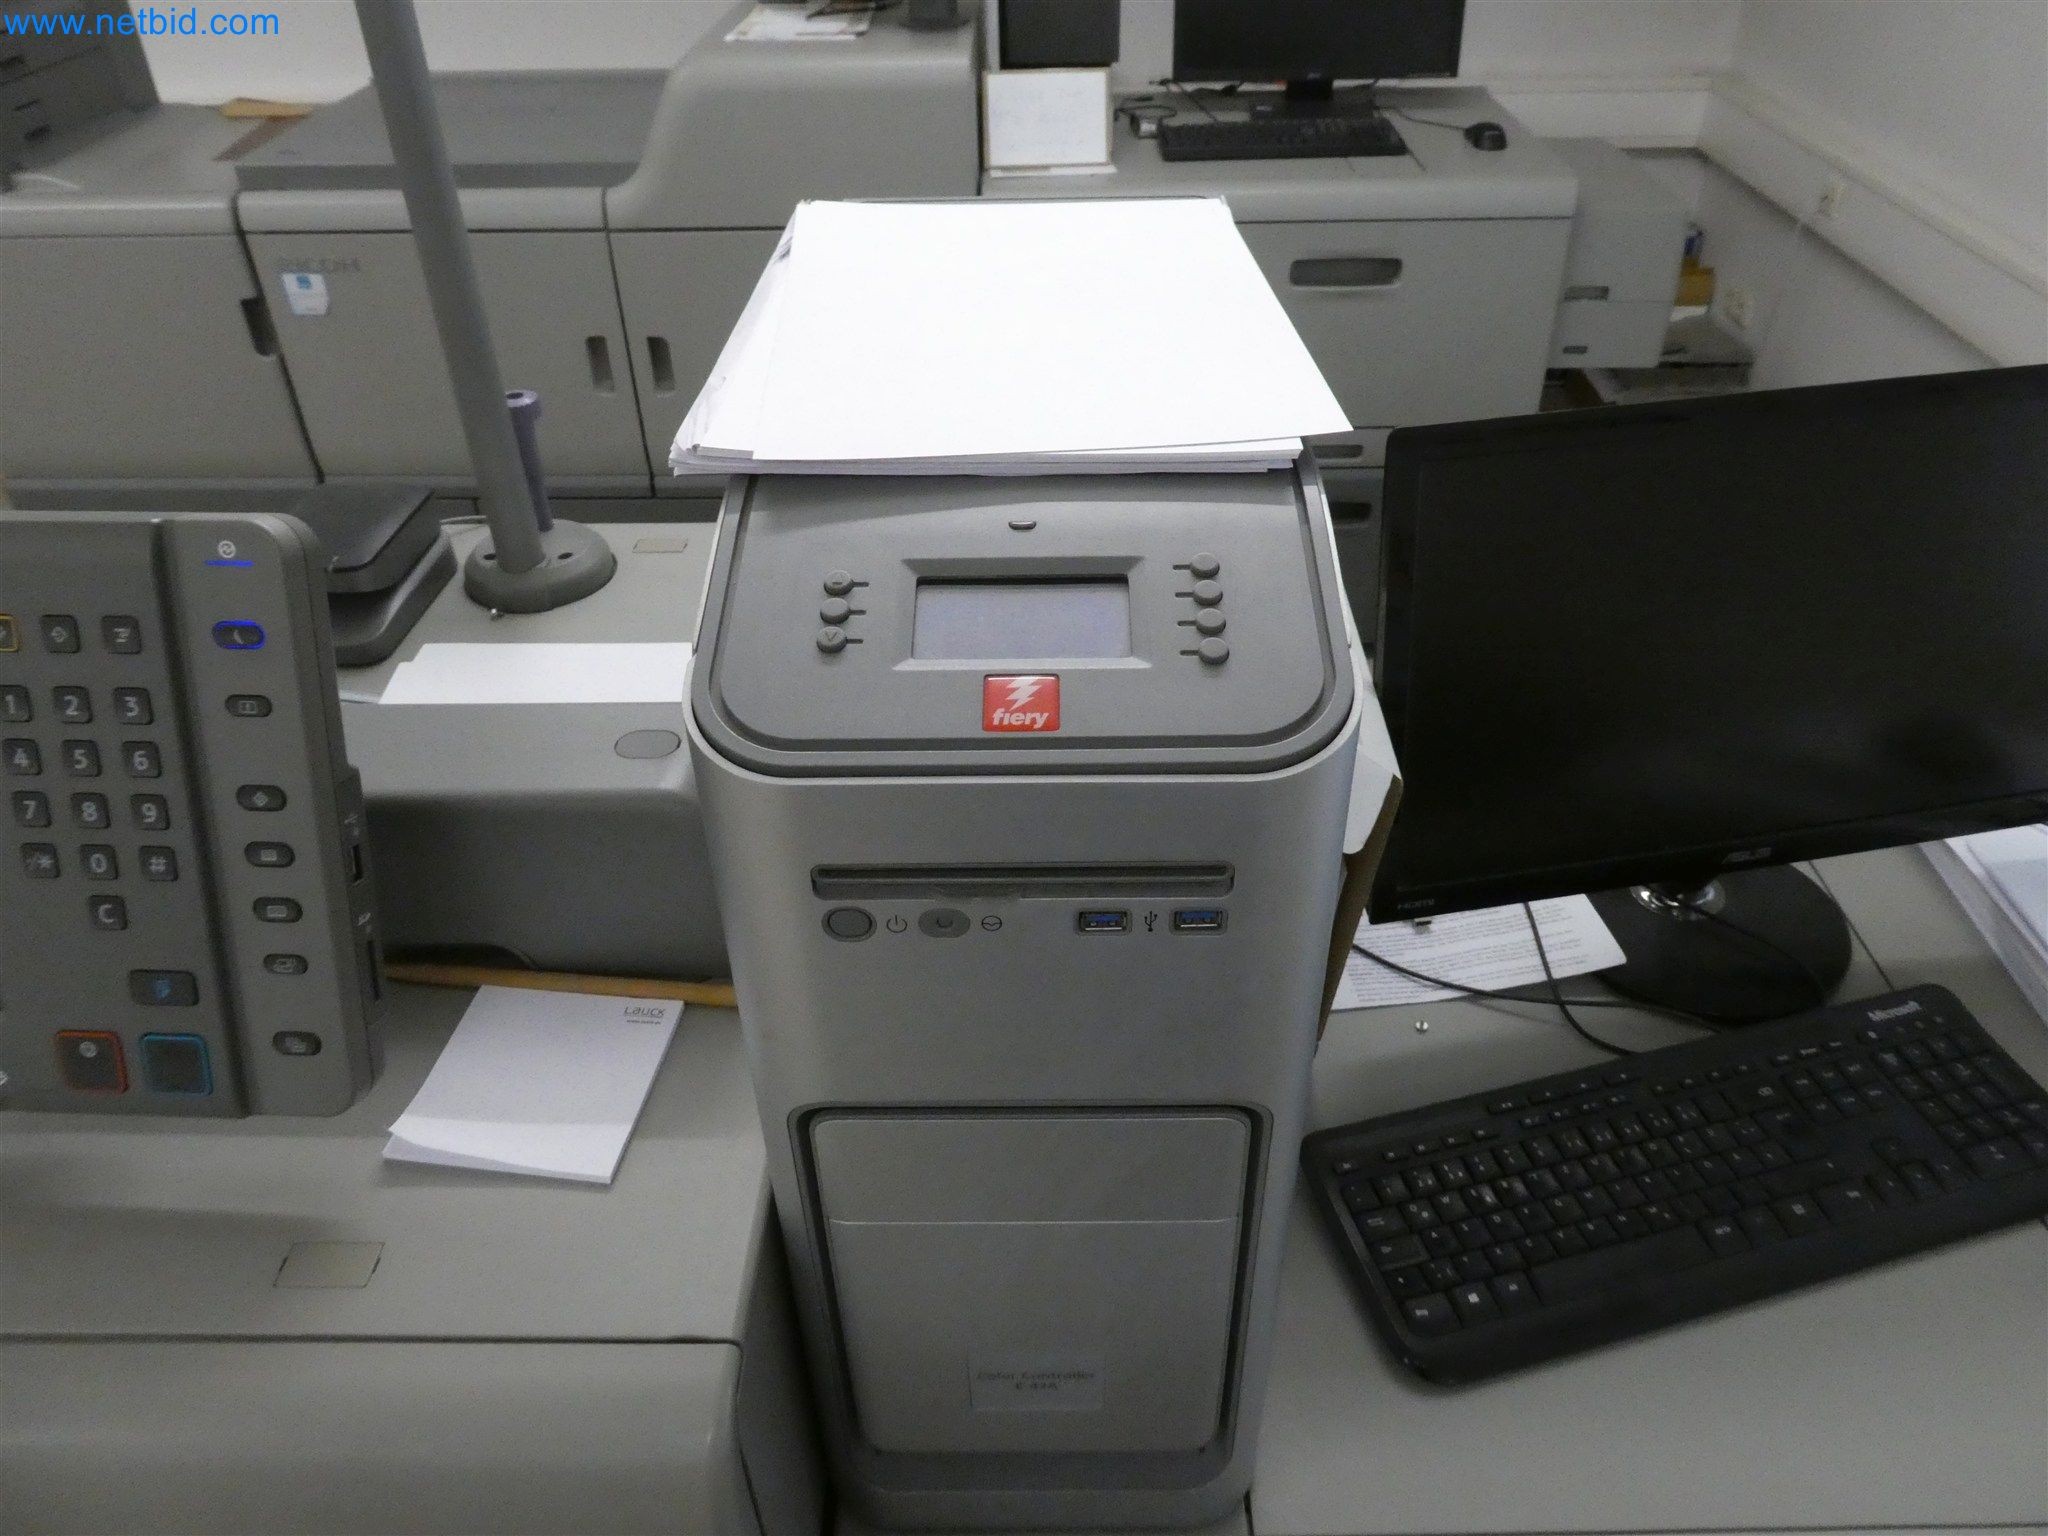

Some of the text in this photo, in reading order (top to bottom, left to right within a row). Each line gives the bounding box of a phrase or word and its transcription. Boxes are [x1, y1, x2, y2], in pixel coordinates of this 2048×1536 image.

[4, 694, 140, 717] 1 2 3
[992, 708, 1050, 730] fiery
[12, 747, 149, 771] 4 5 6
[23, 800, 157, 823] 7 8 9
[91, 853, 107, 873] 0
[98, 904, 114, 924] C
